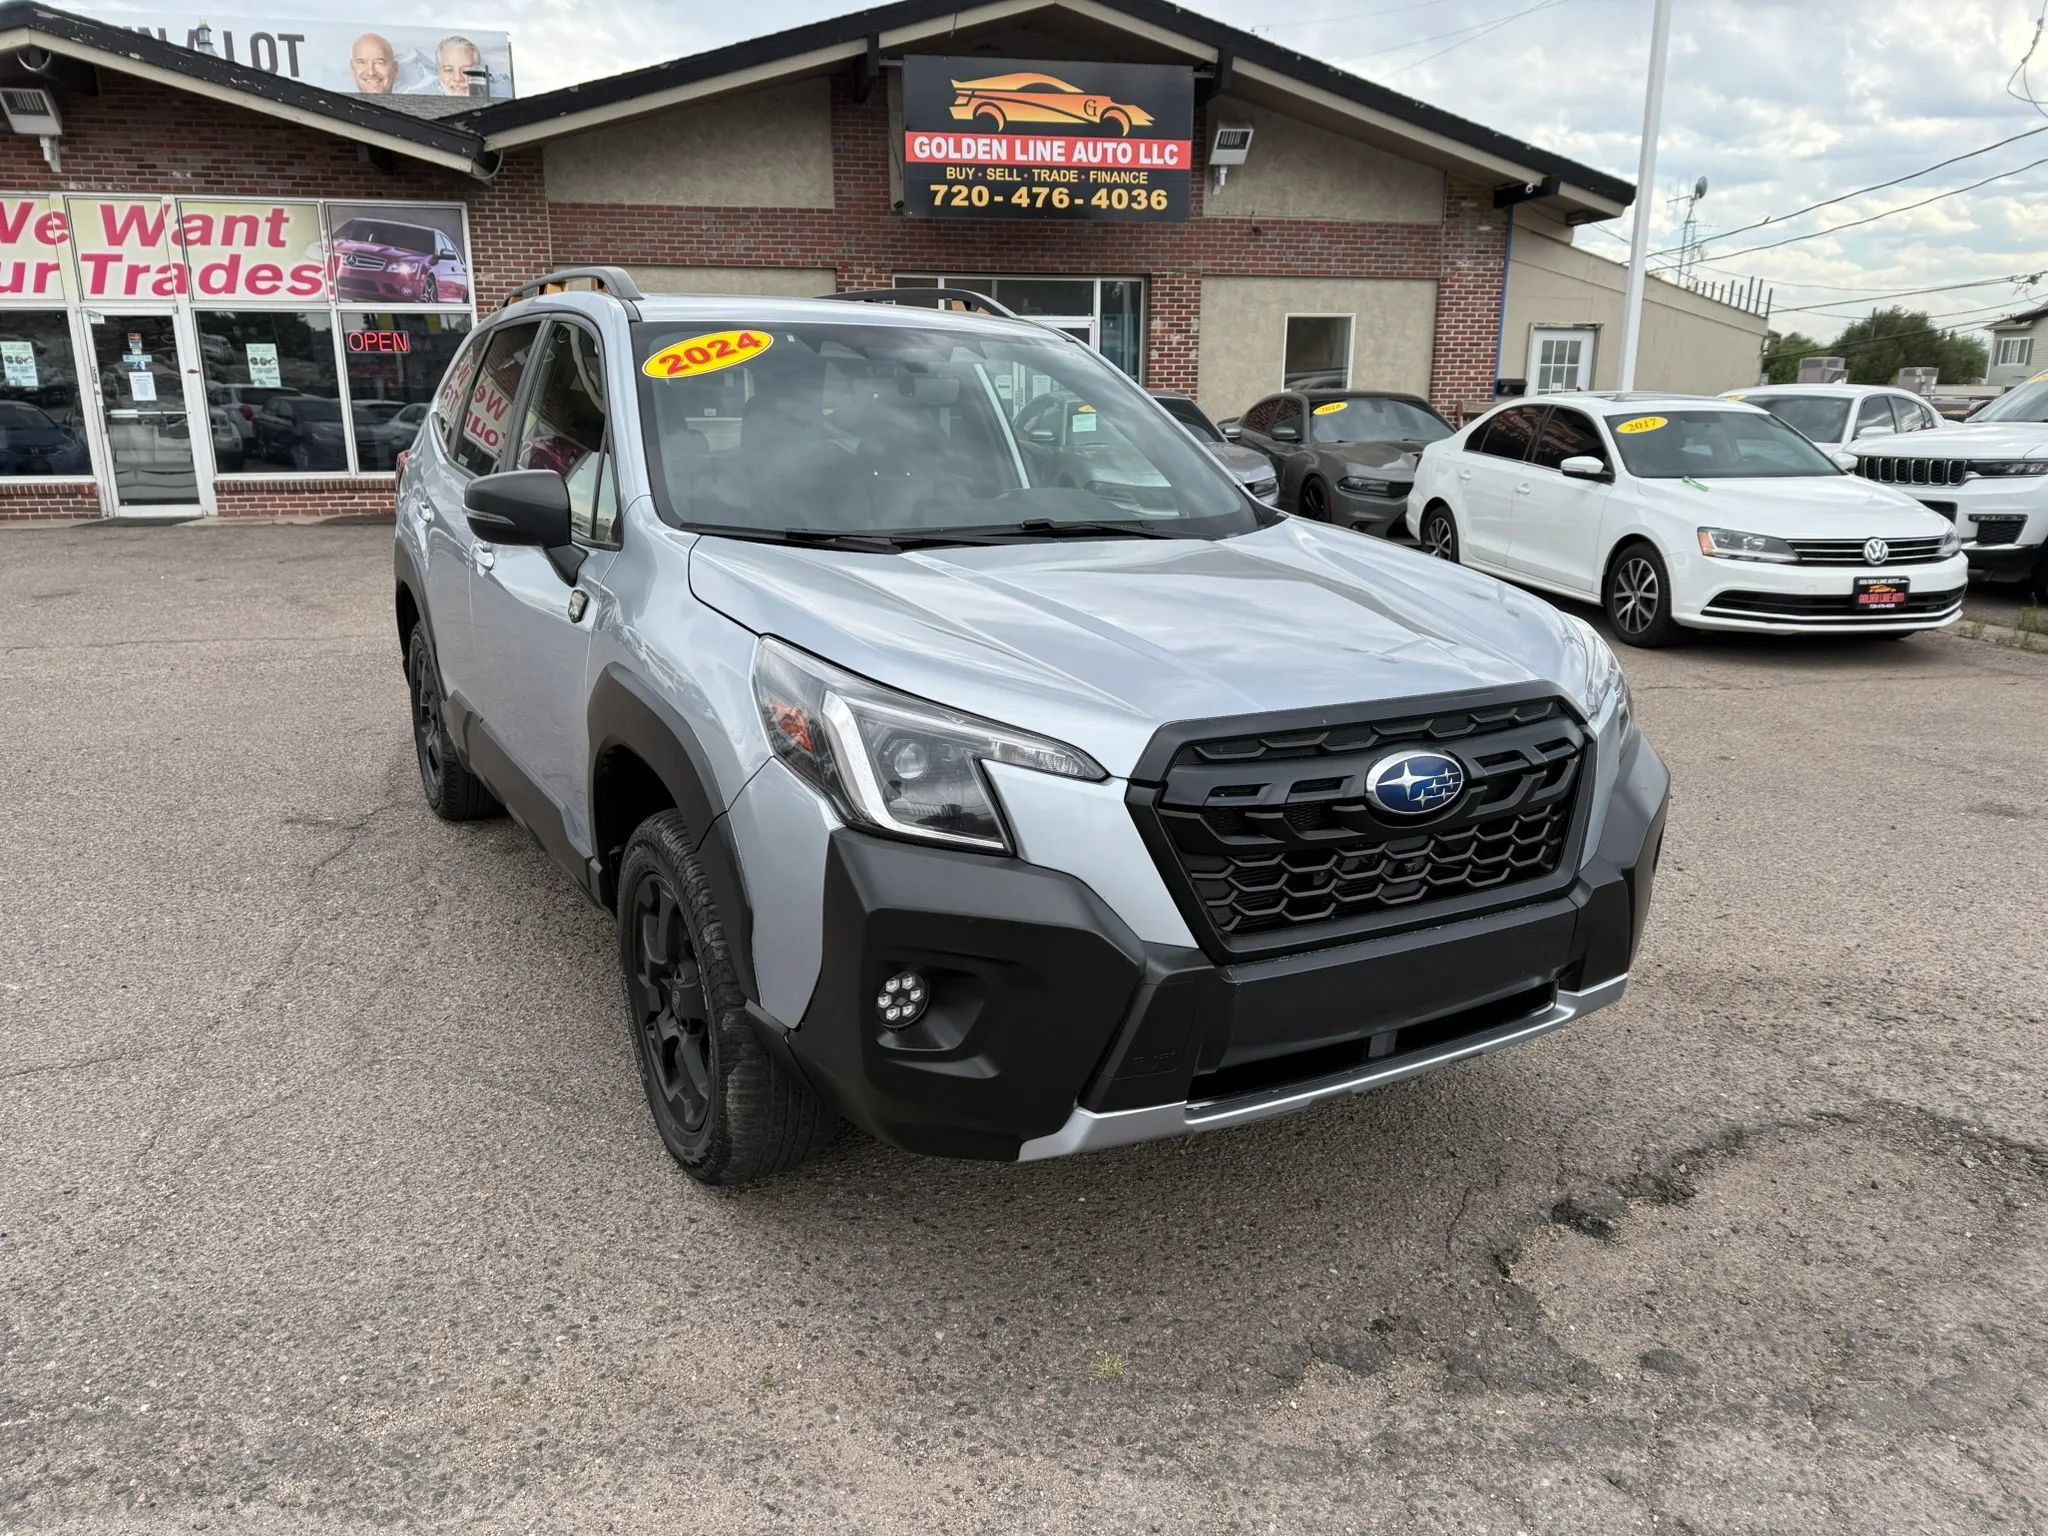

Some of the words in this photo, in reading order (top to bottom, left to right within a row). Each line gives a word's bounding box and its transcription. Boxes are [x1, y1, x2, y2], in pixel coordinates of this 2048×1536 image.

[913, 136, 1008, 161] GOLDEN
[1015, 138, 1066, 163] LINE
[1071, 141, 1133, 164] AUTO
[1139, 143, 1179, 166] LLC
[946, 166, 975, 179] BUY
[986, 168, 1022, 181] SELL
[1031, 169, 1079, 183] TRADE
[1089, 170, 1149, 185] FINANCE
[929, 184, 1169, 212] 720-476-4036
[99, 203, 291, 248] Want
[80, 253, 341, 297] Trades!
[348, 331, 408, 352] OPEN
[658, 332, 762, 375] 2024
[1626, 418, 1656, 431] 2017
